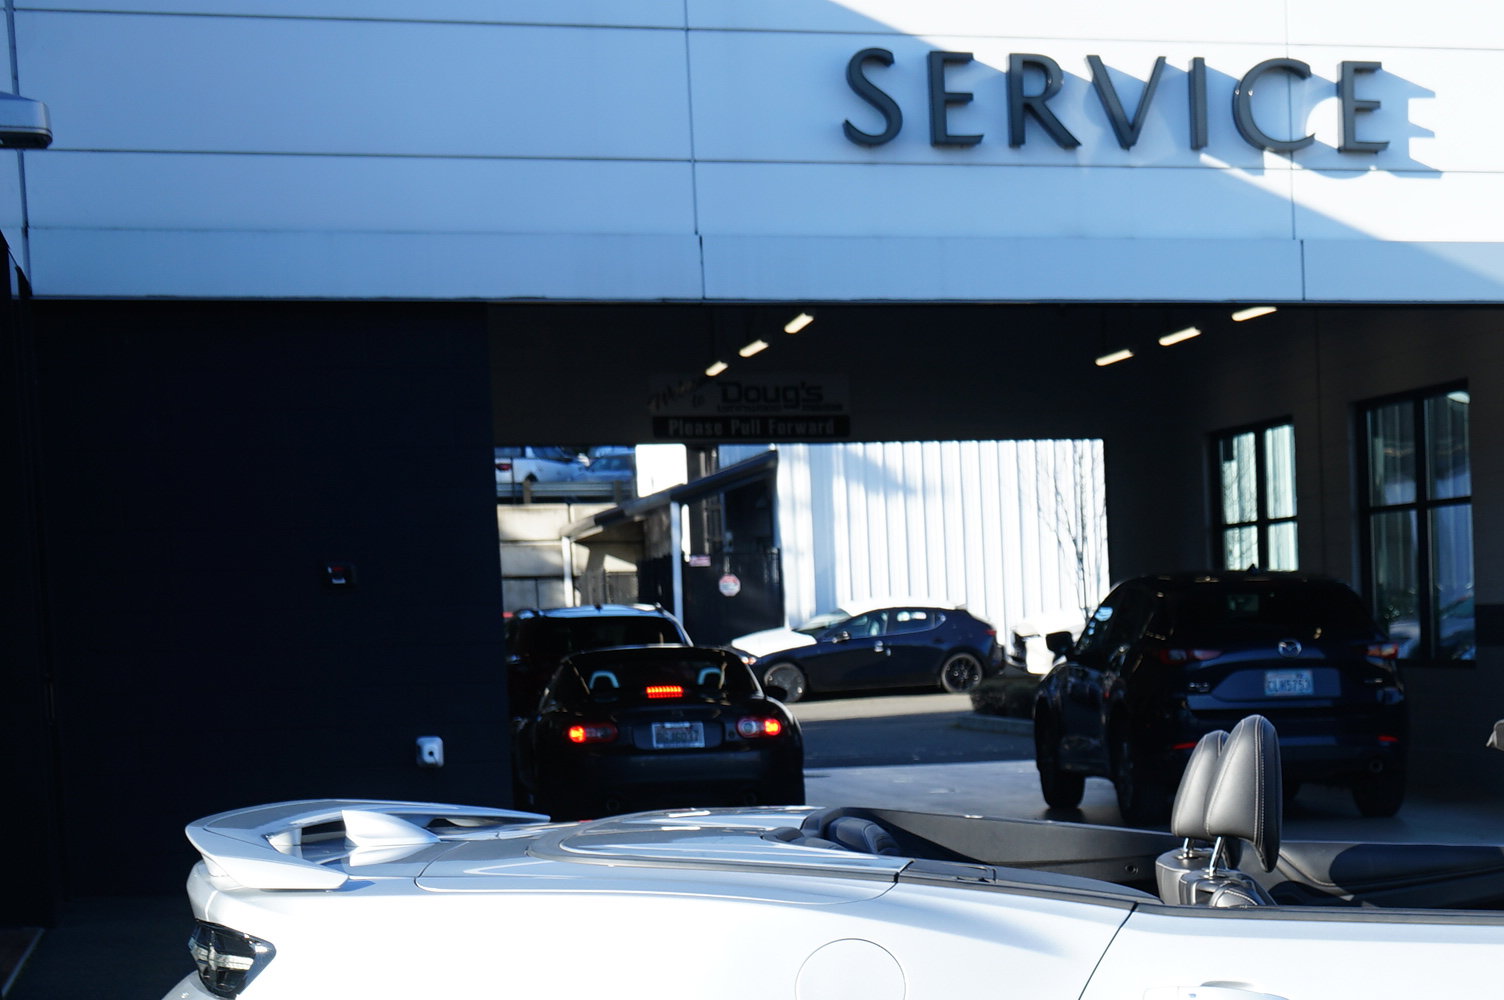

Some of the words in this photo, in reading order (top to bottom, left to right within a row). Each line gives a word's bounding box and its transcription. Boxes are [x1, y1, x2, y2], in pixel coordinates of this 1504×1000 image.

[843, 47, 1391, 155] SERVICE
[717, 380, 824, 409] Doug's
[668, 418, 723, 436] Please
[731, 418, 761, 436] Pull
[768, 418, 835, 436] Forward
